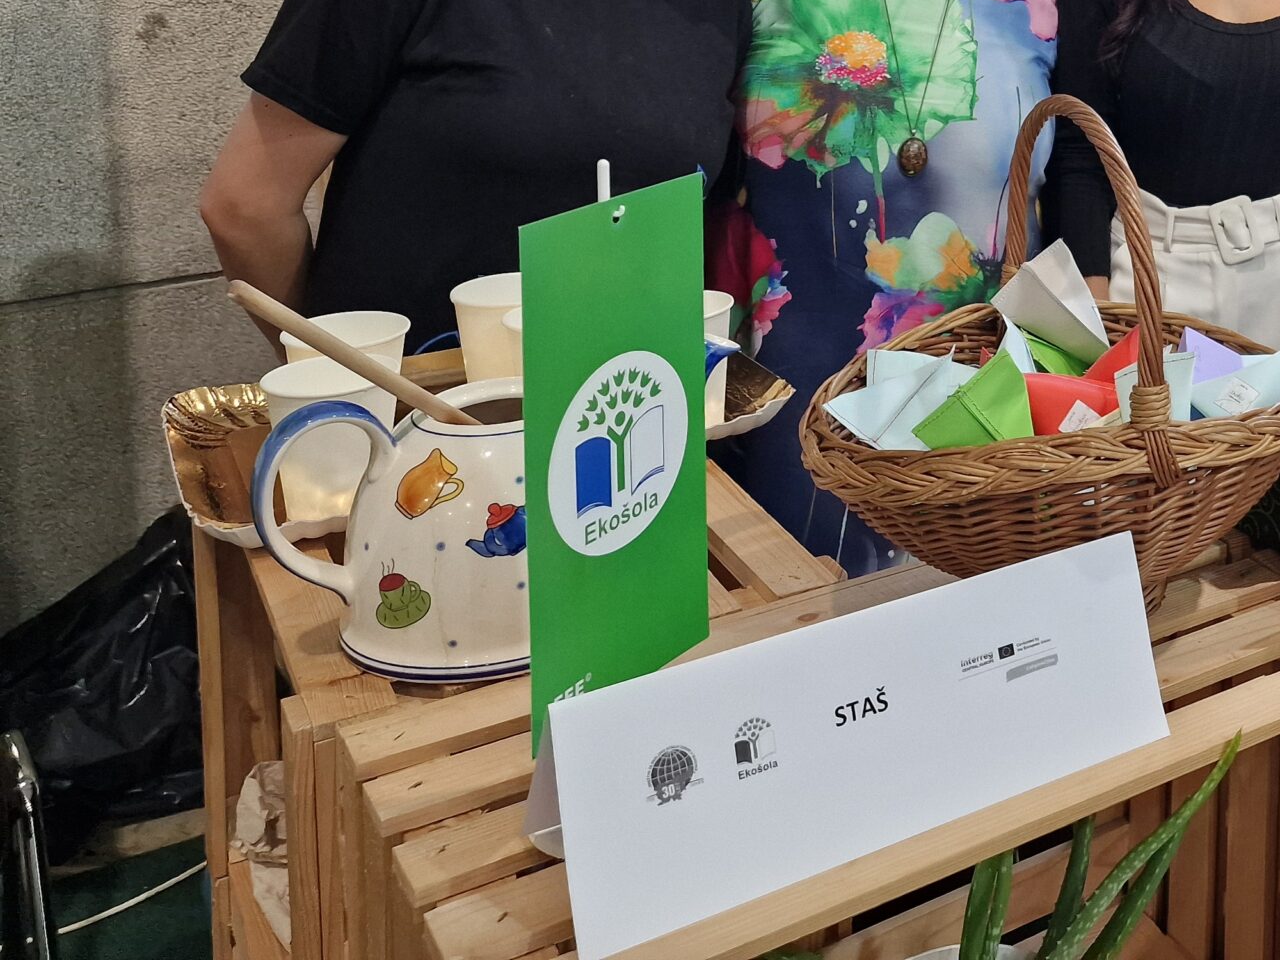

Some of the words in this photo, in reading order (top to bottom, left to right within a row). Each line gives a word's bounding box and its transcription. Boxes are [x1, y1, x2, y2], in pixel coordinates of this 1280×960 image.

[584, 492, 659, 546] Ekošola
[834, 685, 889, 727] STAŠ
[737, 759, 779, 780] Ekošola
[661, 784, 675, 799] 30
